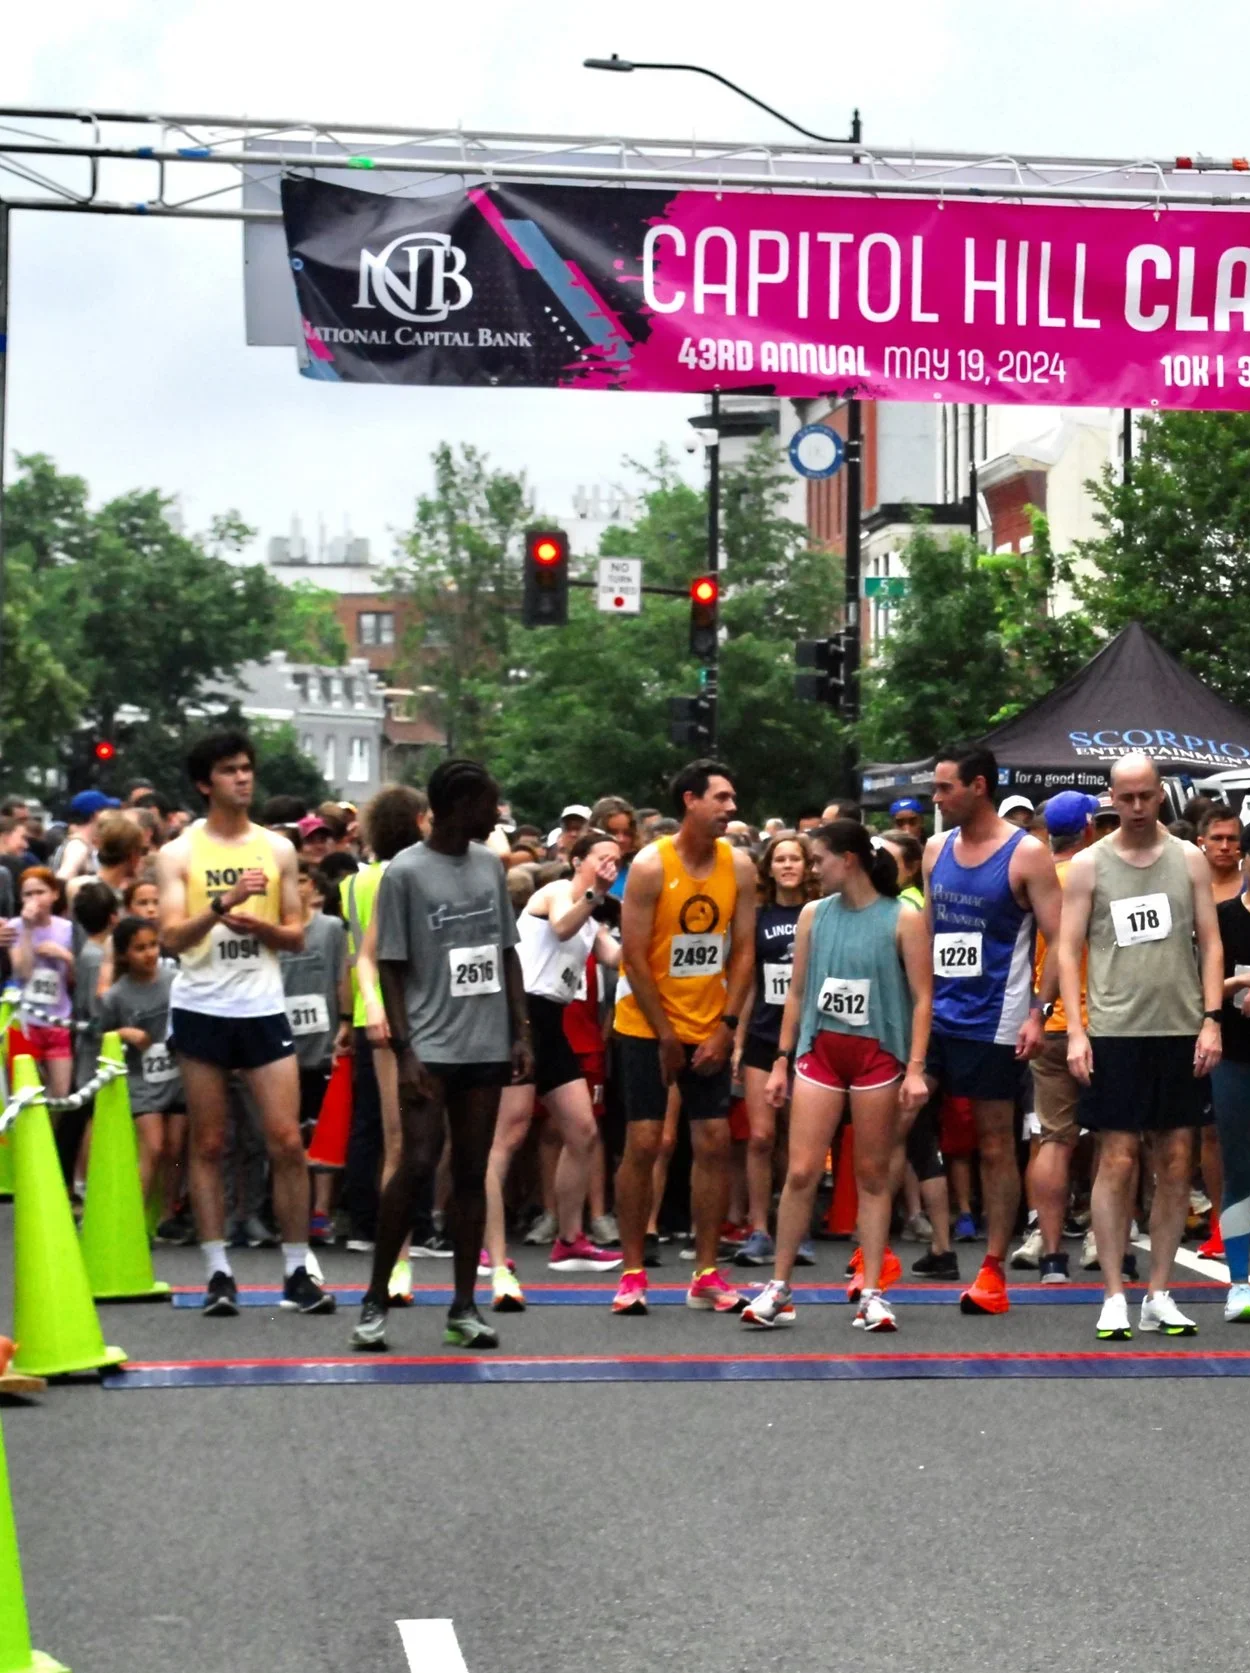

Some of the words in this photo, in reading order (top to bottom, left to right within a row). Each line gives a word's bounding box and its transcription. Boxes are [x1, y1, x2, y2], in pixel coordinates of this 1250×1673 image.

[643, 224, 940, 323] CAPITOL
[964, 237, 1101, 329] HILL
[677, 338, 754, 371] 43RD
[761, 341, 871, 377] ANNUAL
[884, 346, 949, 381] MAY
[957, 349, 991, 385] 19,
[998, 350, 1067, 384] 2024
[1160, 355, 1209, 387] 10K
[611, 563, 630, 573] NO
[1069, 729, 1250, 758] SCORPIO
[1015, 771, 1032, 784] for
[1034, 775, 1042, 784] a
[1045, 773, 1075, 787] good
[1078, 772, 1108, 786] time,
[1127, 909, 1160, 932] 178
[672, 945, 718, 967] 2492
[939, 946, 977, 967] 1228
[456, 961, 494, 985] 2516
[822, 991, 865, 1014] 2512
